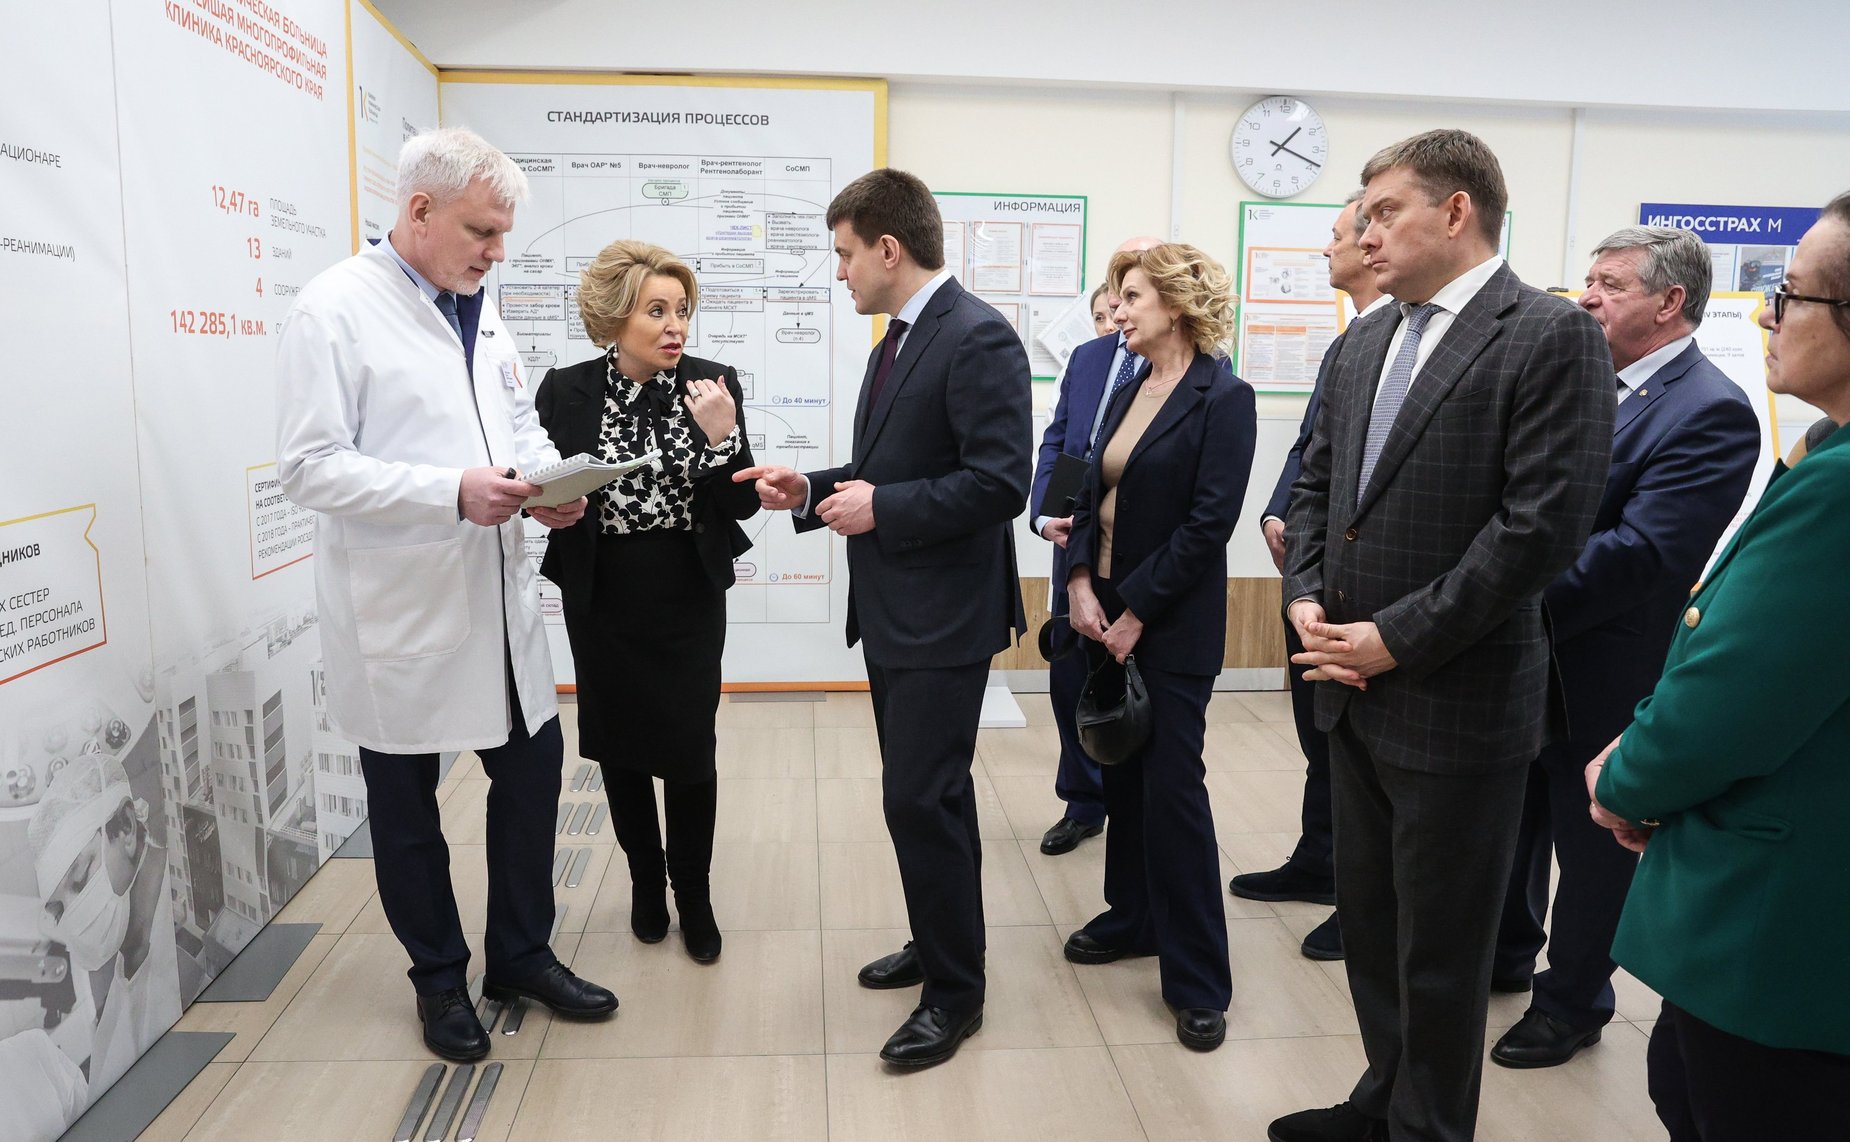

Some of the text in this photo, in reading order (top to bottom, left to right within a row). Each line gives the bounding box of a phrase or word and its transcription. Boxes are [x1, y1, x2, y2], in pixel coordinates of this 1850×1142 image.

[282, 16, 327, 58] БОЛЬНИЦА
[165, 0, 323, 101] КЛИНИКА КРАСНОЯРСКОГО КРАЯ
[237, 12, 327, 80] МНОГОПРОФИЛЬНАЯ
[1279, 105, 1291, 113] 12
[547, 110, 769, 127] СТАНДАРТИЗАЦИЯ ПРОЦЕССОВ
[1249, 122, 1261, 130] 10
[1242, 139, 1250, 147] 9
[1311, 146, 1319, 154] 3
[571, 161, 589, 169] Врач
[638, 162, 690, 170] Врач-невролог
[701, 159, 762, 167] Врач-рентгенолог
[1245, 157, 1253, 165] 8
[1305, 163, 1313, 171] 4
[1257, 172, 1265, 180] 7
[1291, 176, 1299, 184] 5
[212, 185, 259, 217] 12,47 га
[270, 198, 297, 216] ПЛОЩАДЬ
[993, 201, 1081, 214] ИНФОРМАЦИЯ
[270, 214, 327, 239] ЗЕМЕЛЬНОГО УЧАСТКА
[1648, 215, 1761, 233] ИНГОССТРАХ
[247, 237, 261, 259] 13
[272, 246, 292, 260] ЗДАНИЙ
[256, 277, 263, 298] 4
[1713, 311, 1742, 319] ЭТАПЫ)
[171, 309, 195, 334] 142
[199, 310, 236, 339] 285,1
[256, 500, 263, 509] НА
[261, 512, 273, 525] 2017
[274, 509, 287, 521] ГОДА
[262, 529, 274, 542] 2018
[274, 525, 287, 537] ГОДА
[0, 543, 41, 567] НИКОВ
[782, 573, 792, 581] До
[803, 574, 824, 582] минут
[9, 587, 50, 610] СЕСТЕР
[20, 600, 84, 631] ПЕРСОНАЛА
[27, 617, 96, 652] РАБОТНИКОВ
